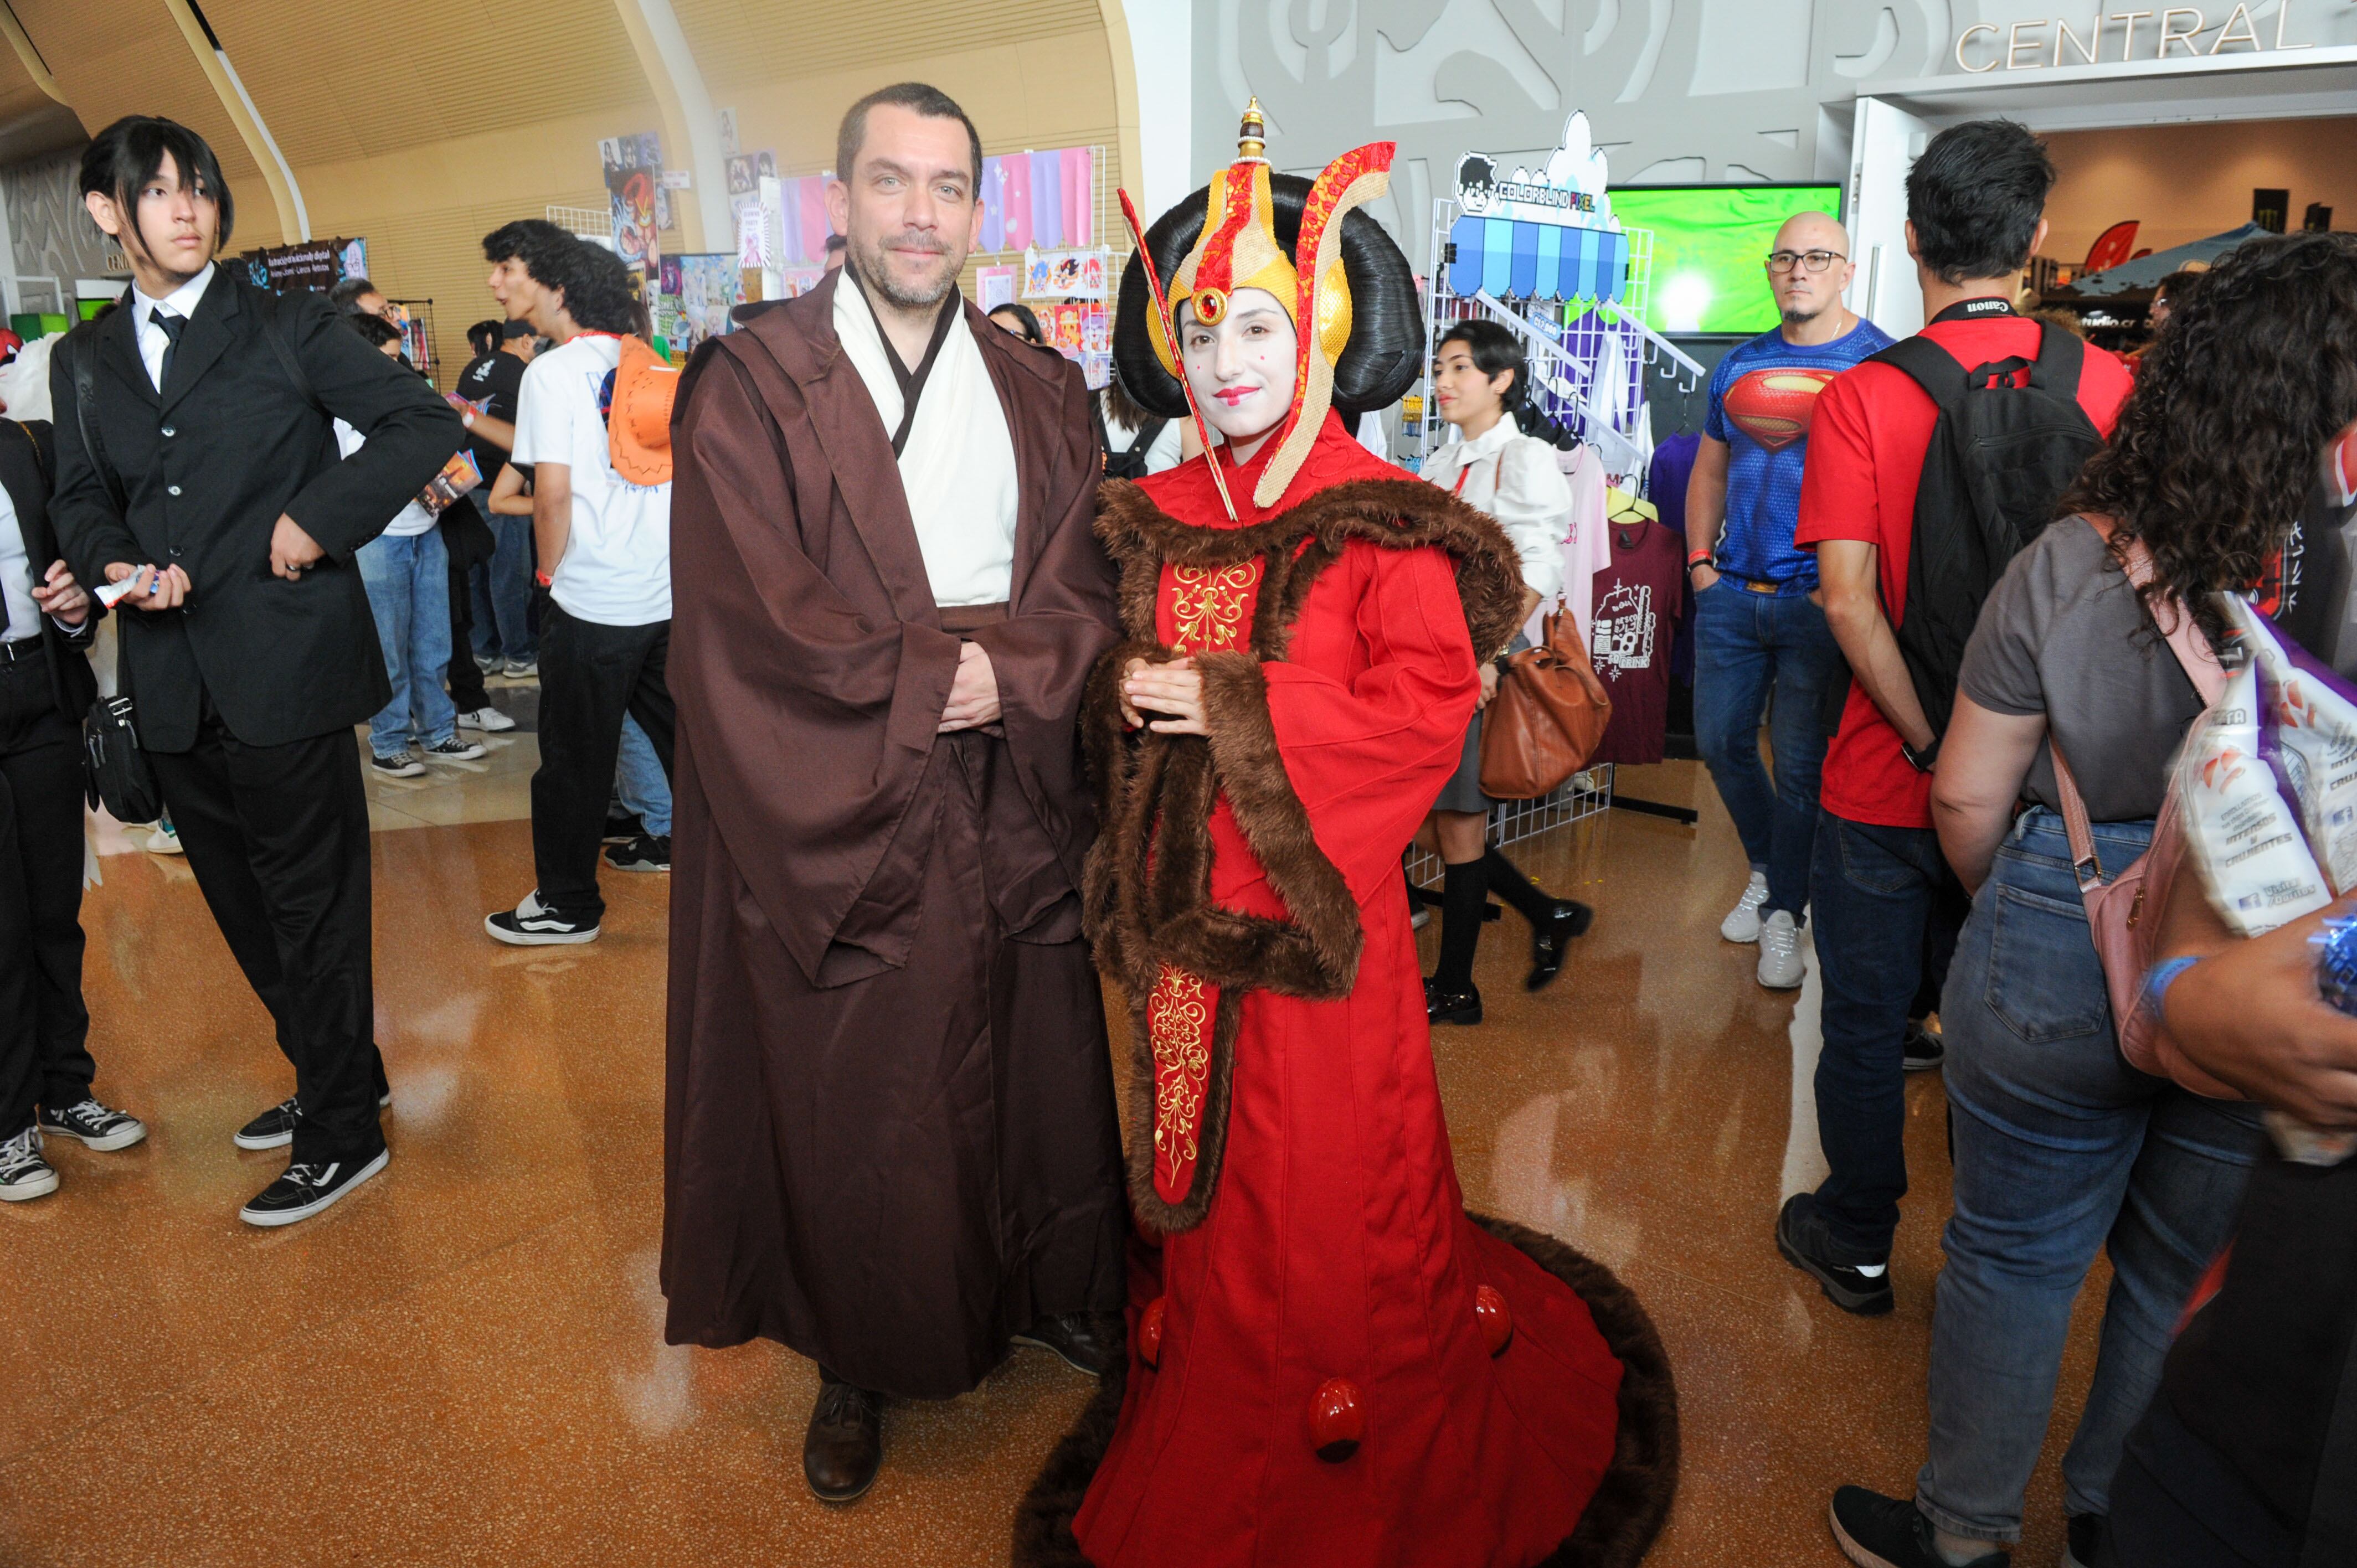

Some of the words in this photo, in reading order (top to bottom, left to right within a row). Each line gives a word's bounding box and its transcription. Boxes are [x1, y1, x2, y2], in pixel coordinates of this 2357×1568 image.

[1955, 0, 2314, 73] CENTRAL
[1499, 182, 1569, 208] COLORBLIND
[1569, 192, 1595, 212] PIXEL
[1967, 301, 2009, 312] Canon
[2081, 316, 2136, 327] tudio.cr
[1620, 657, 1650, 668] DRINK
[2225, 832, 2293, 868] CRUJIENTES
